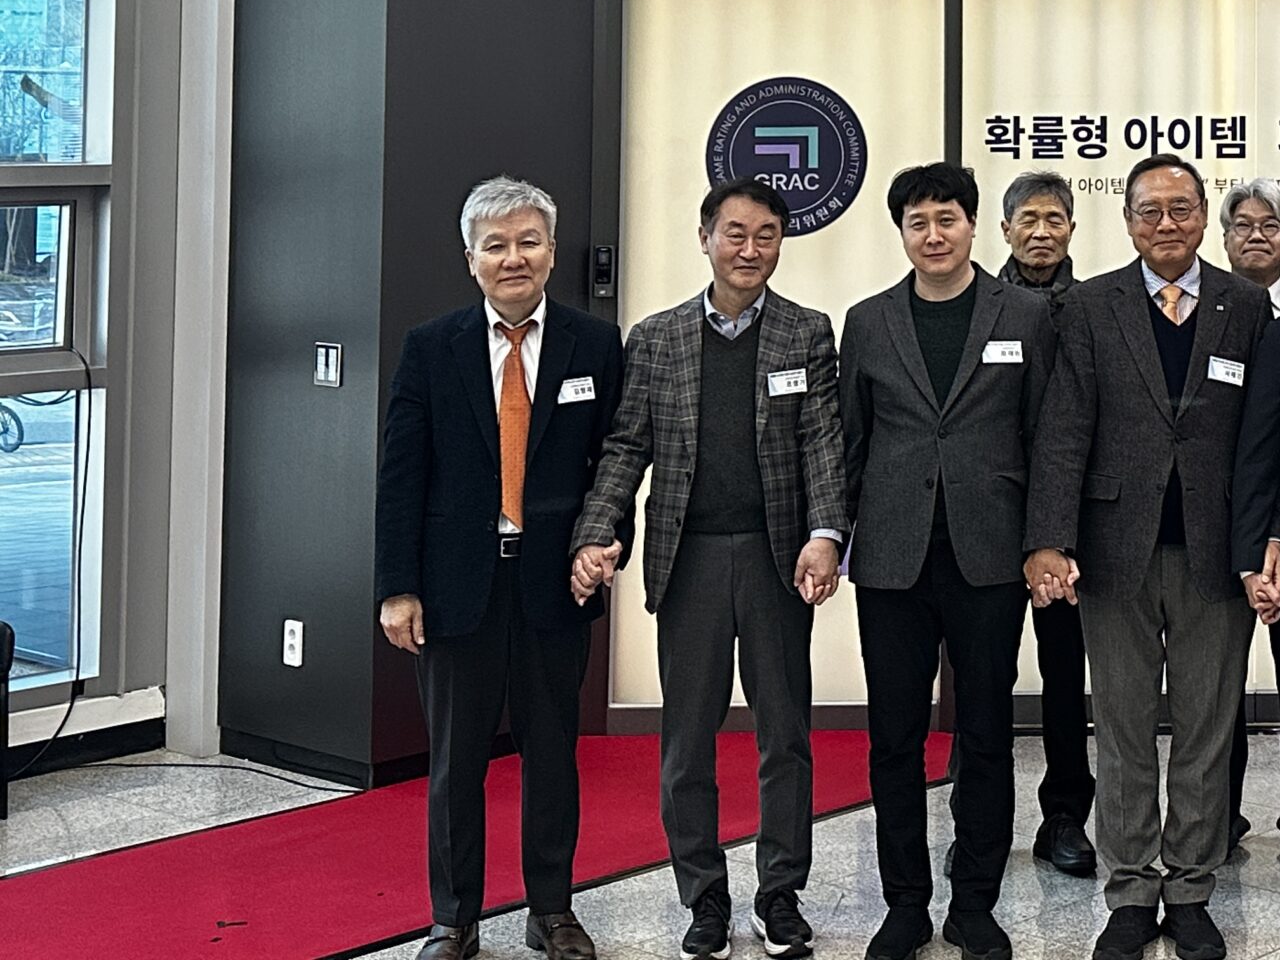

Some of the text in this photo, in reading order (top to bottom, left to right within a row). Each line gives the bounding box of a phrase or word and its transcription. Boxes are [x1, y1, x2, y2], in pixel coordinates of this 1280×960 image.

[713, 112, 736, 153] RATING
[734, 94, 757, 115] AND
[758, 84, 846, 121] ADMINISTRATION
[842, 120, 861, 188] COMMITTEE
[985, 115, 1108, 160] 확률형
[1124, 115, 1246, 160] 아이템
[788, 196, 843, 230] 리위원회
